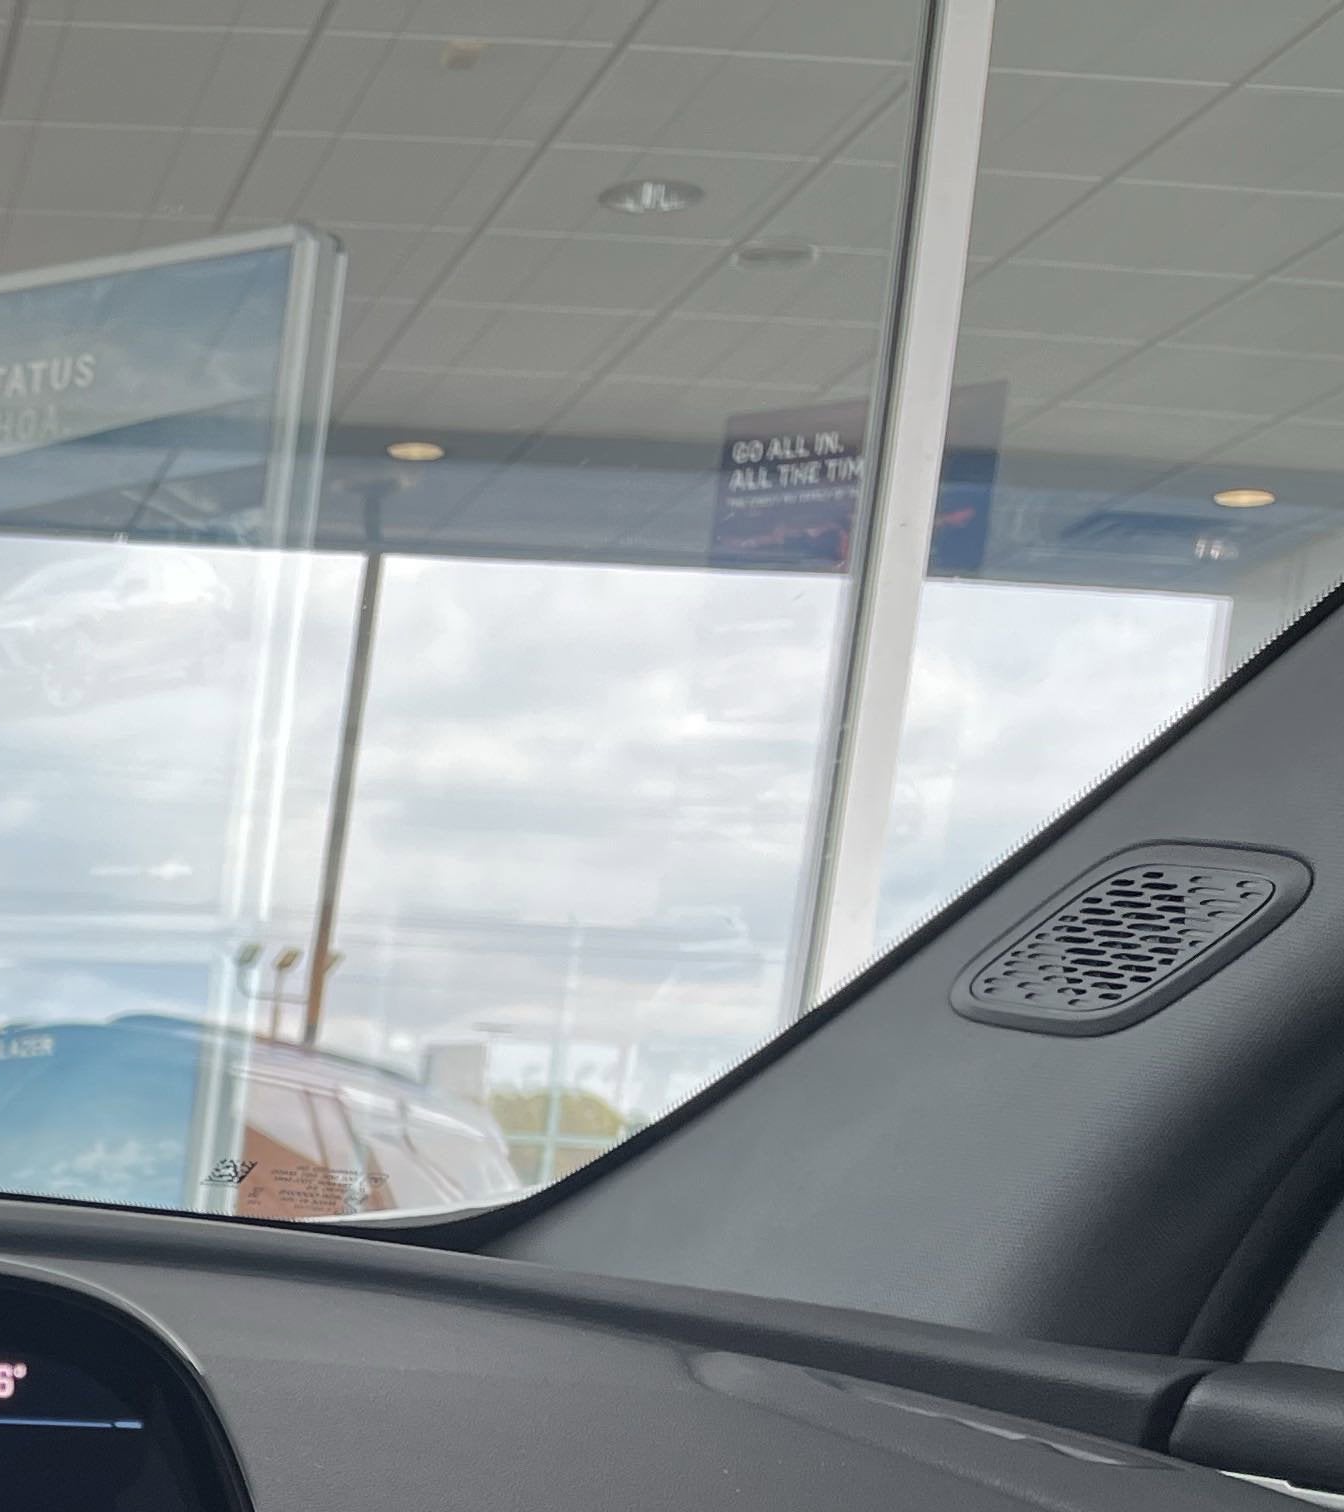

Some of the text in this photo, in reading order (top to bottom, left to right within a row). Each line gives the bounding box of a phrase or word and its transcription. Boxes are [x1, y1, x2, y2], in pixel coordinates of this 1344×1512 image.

[732, 431, 844, 464] GO ALL IN.
[729, 466, 772, 491] ALL
[777, 461, 822, 488] THE
